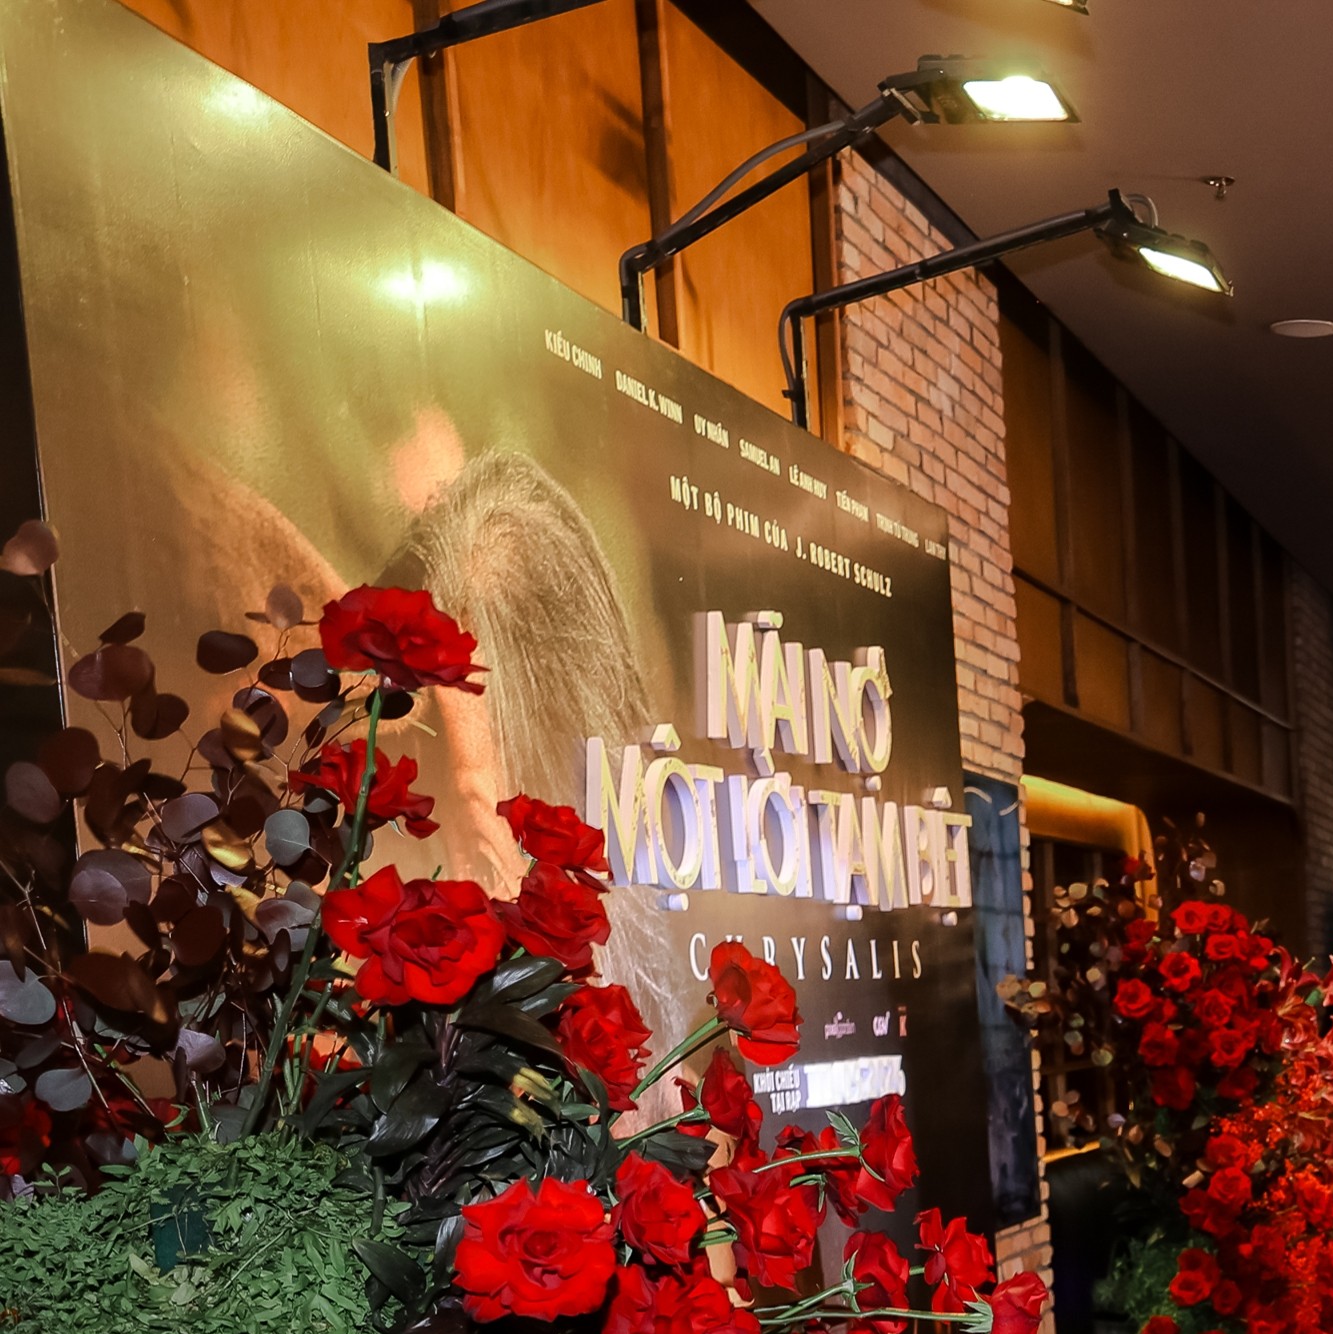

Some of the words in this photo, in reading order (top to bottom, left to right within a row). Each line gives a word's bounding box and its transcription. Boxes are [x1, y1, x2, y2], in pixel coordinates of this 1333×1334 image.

[571, 345, 602, 379] CHINH
[615, 370, 649, 406] DANIEL
[658, 394, 683, 424] WINN
[739, 439, 770, 471] SAMUEL
[670, 475, 699, 510] MỘT
[704, 491, 722, 524] BỘ
[726, 503, 760, 538] PHIM
[764, 519, 789, 551] CỦA
[795, 536, 807, 560] J.
[810, 542, 850, 579] ROBERT
[853, 562, 892, 598] SCHULZ
[586, 723, 724, 911] MỘT
[808, 788, 909, 922] TẠM
[688, 933, 923, 981] CRYSALIS
